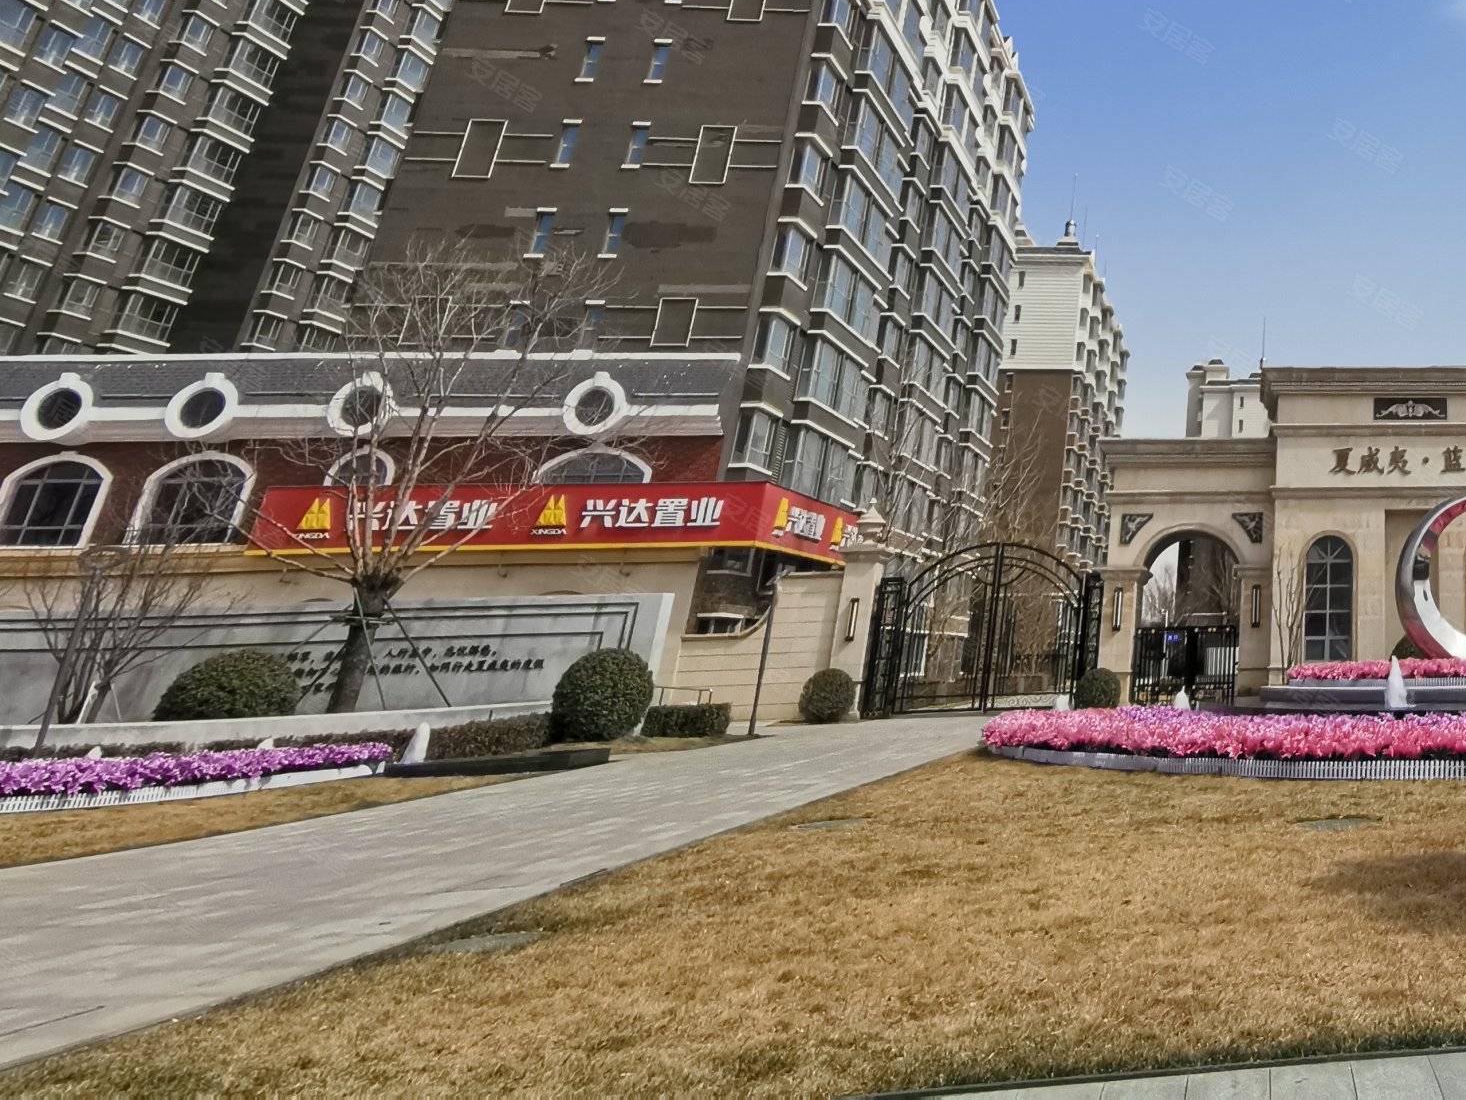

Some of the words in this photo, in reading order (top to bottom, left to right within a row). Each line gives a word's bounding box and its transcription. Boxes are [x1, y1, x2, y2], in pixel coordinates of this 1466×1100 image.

[580, 497, 724, 528] 兴达置业
[530, 528, 567, 536] XINGDA
